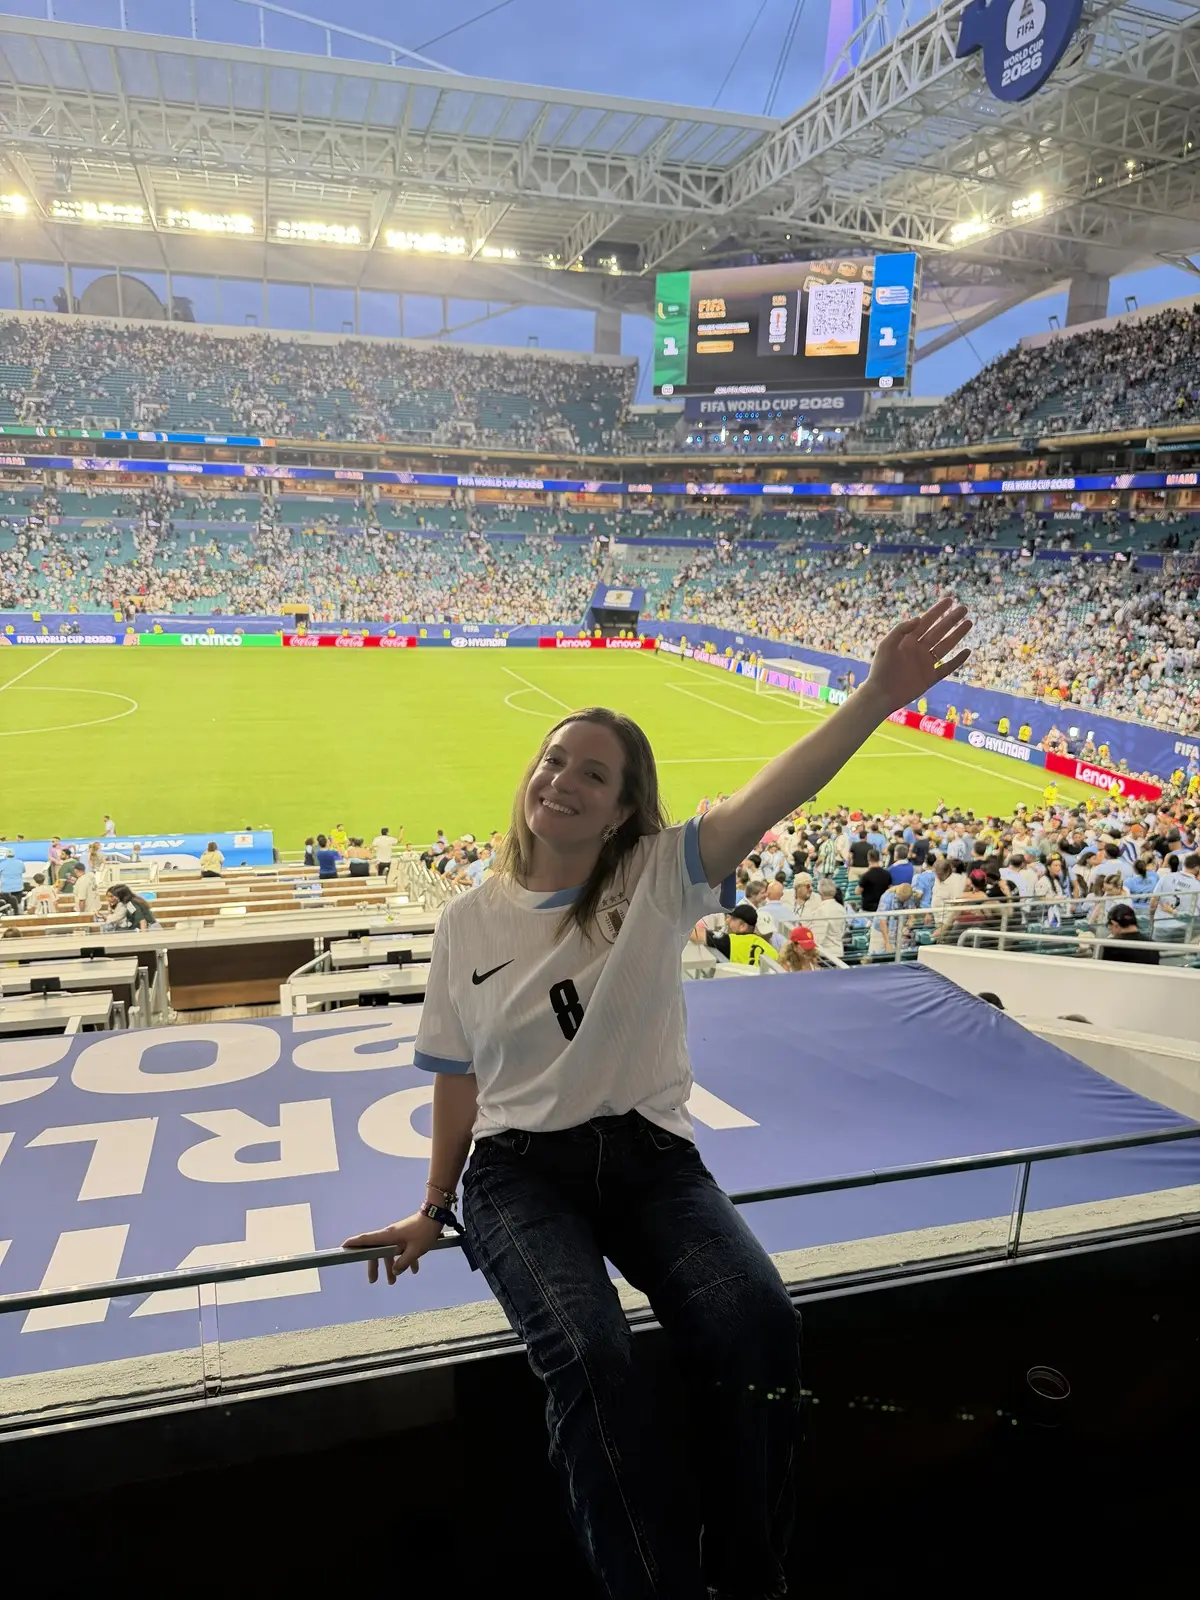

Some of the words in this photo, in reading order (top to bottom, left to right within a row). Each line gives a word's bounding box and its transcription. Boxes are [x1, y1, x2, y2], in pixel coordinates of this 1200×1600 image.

[1016, 20, 1035, 39] FIFA
[1003, 48, 1029, 70] WORLD
[1028, 39, 1044, 57] CUP
[1001, 52, 1042, 87] 2026
[698, 298, 726, 312] FIFA
[879, 327, 897, 346] 1
[663, 337, 678, 355] 1
[700, 401, 726, 412] FIFA
[727, 400, 771, 412] WORLD
[772, 399, 798, 410] CUP
[799, 397, 845, 410] 2026
[457, 477, 475, 486] FIFA
[475, 478, 501, 488] WORLD
[1002, 480, 1015, 491] FIFA
[1015, 479, 1038, 490] WORLD
[1037, 478, 1051, 490] CUP
[1166, 474, 1198, 485] MIAMI
[17, 635, 36, 644] FIFA
[36, 635, 67, 644] WORLD
[67, 635, 84, 644] CUP
[180, 634, 242, 646] aramco
[468, 637, 507, 648] HYUNDAI
[556, 637, 591, 648] Lenovo
[606, 637, 642, 648] Lenovo
[985, 736, 1031, 761] HYUNDAI
[1174, 741, 1199, 760] FIFA
[549, 979, 584, 1042] 8
